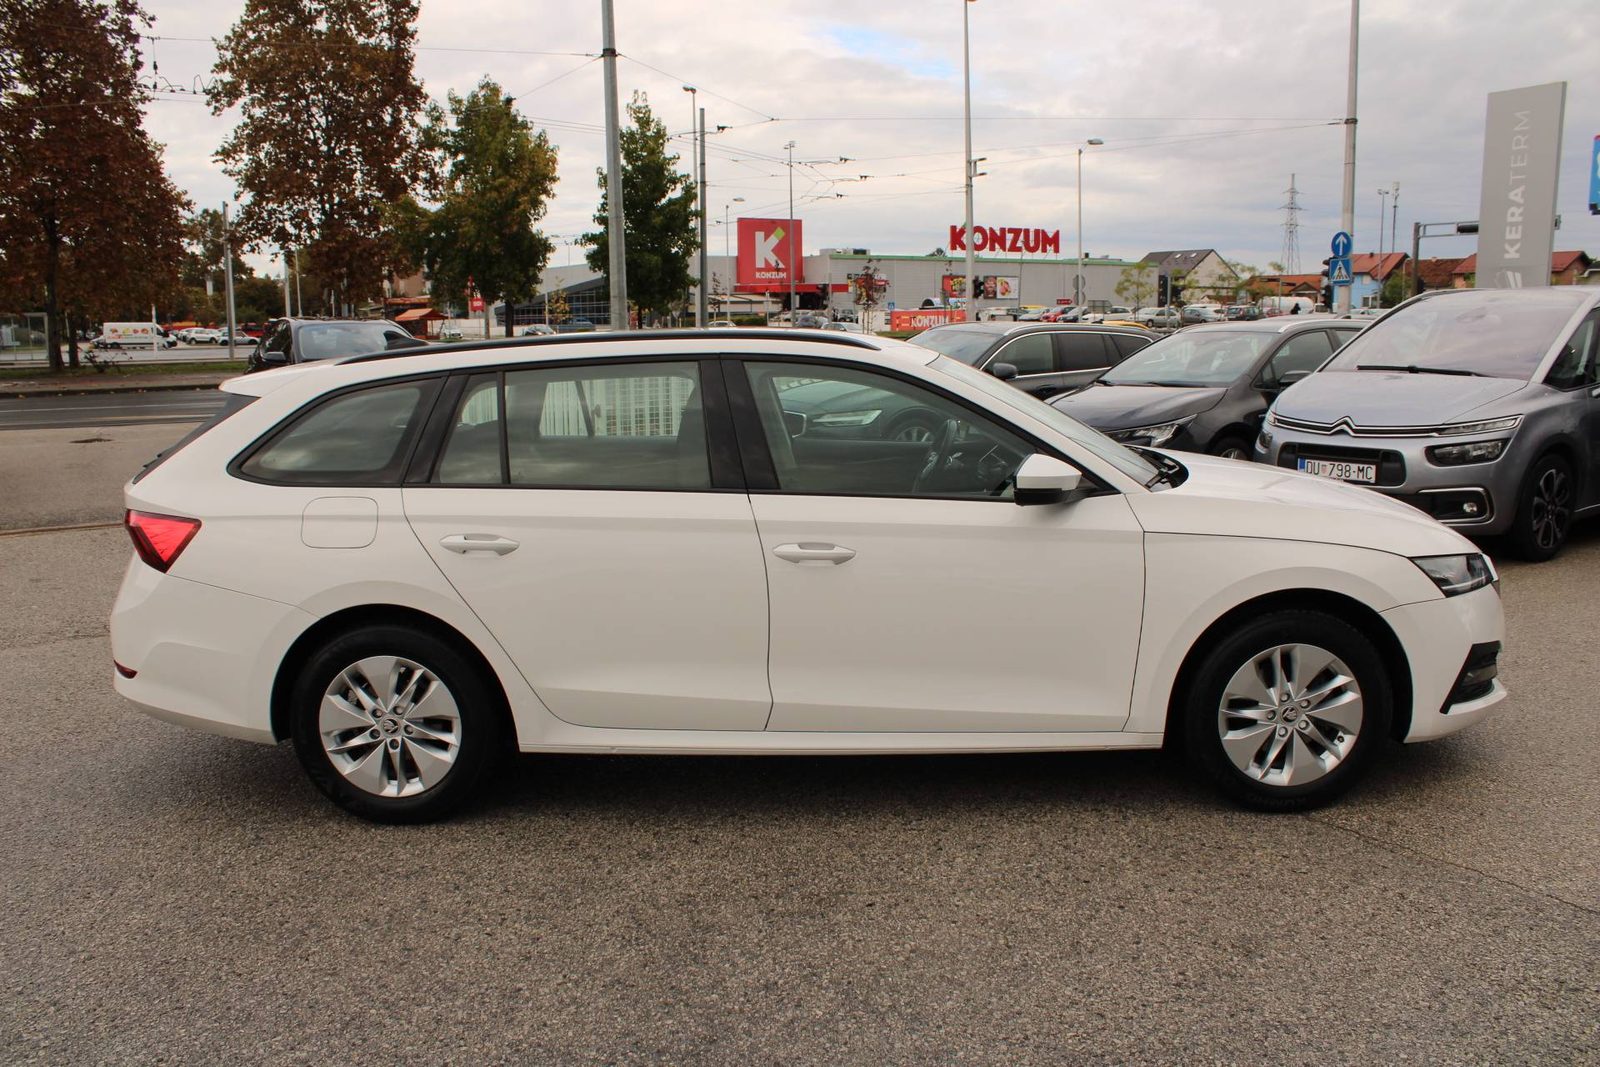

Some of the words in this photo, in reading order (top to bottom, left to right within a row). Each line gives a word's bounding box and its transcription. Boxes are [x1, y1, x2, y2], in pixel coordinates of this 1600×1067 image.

[1503, 110, 1531, 259] KERATERM
[950, 225, 1060, 253] KONZUM
[755, 271, 787, 279] KONZUM
[911, 314, 949, 328] KONZUM
[1306, 461, 1320, 475] DU
[1328, 463, 1373, 480] 798-MC
